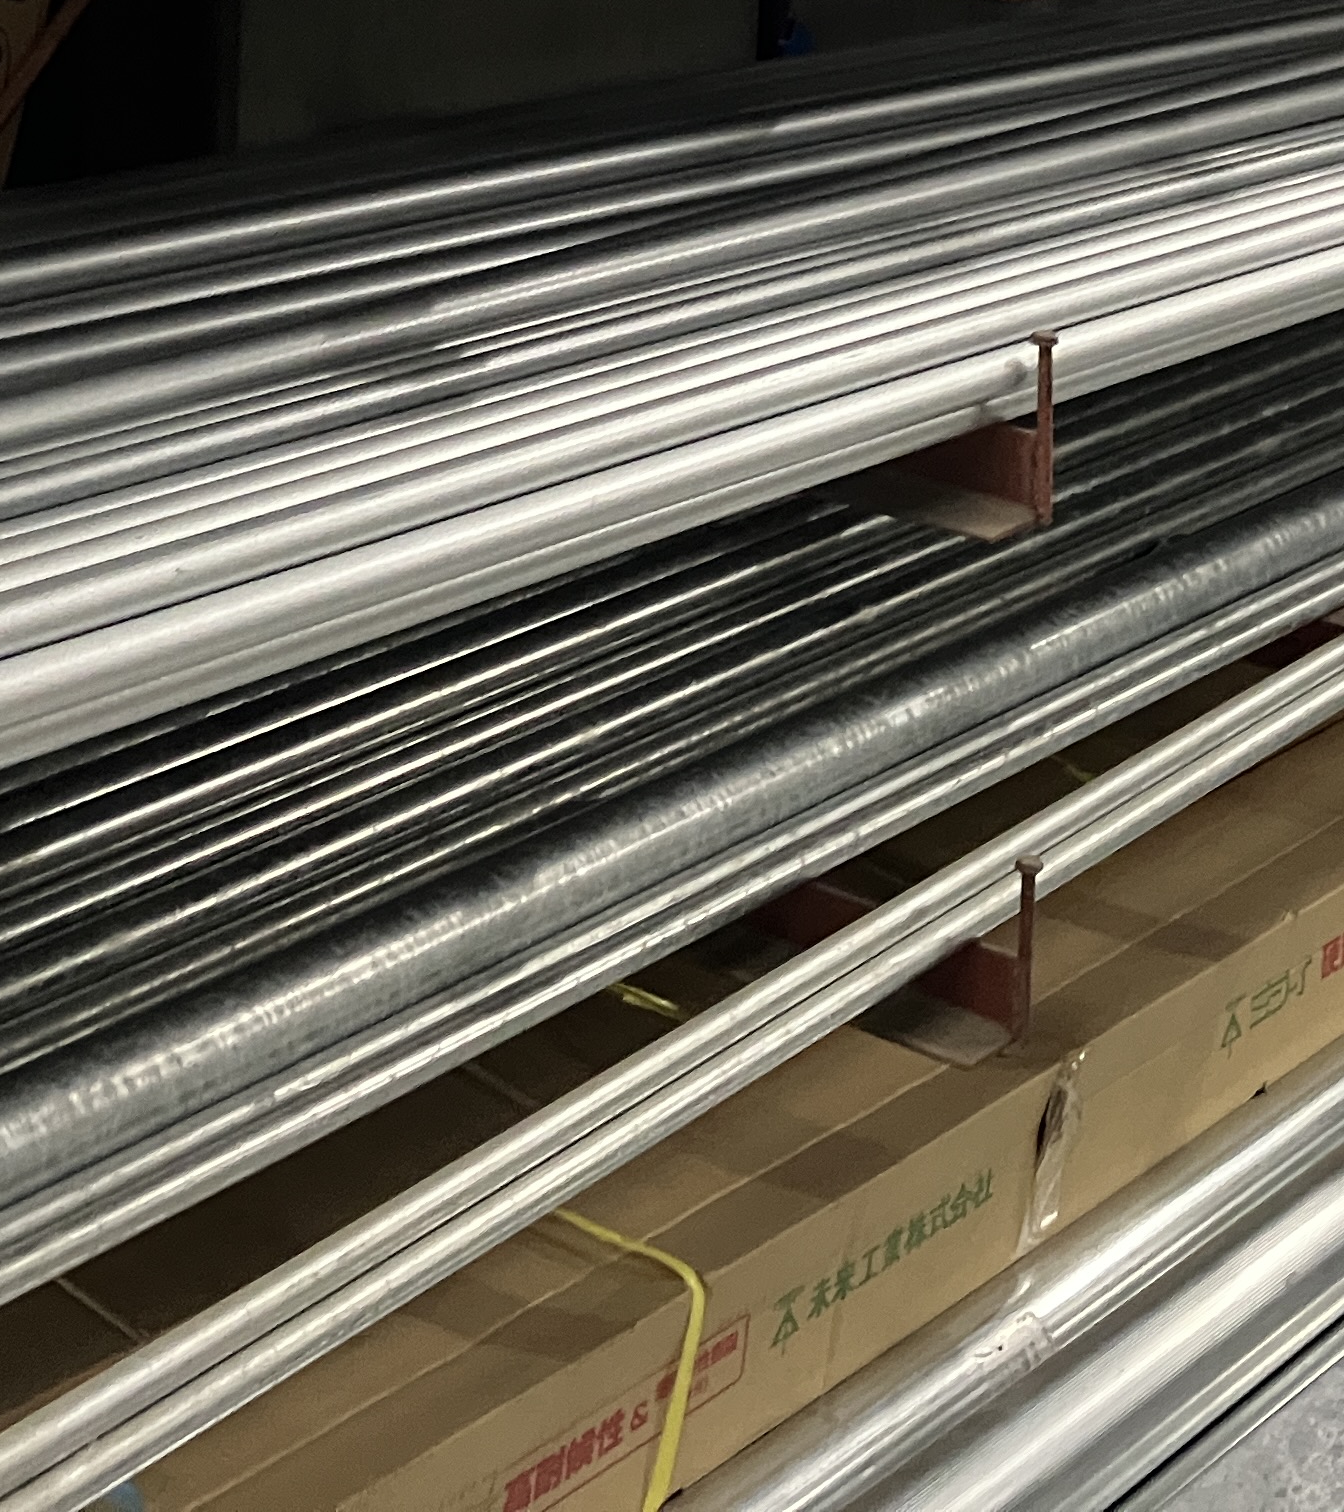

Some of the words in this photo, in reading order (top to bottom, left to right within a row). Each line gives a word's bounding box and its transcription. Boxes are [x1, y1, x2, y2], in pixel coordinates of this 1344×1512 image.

[806, 1168, 994, 1321] 未来工業株式会社
